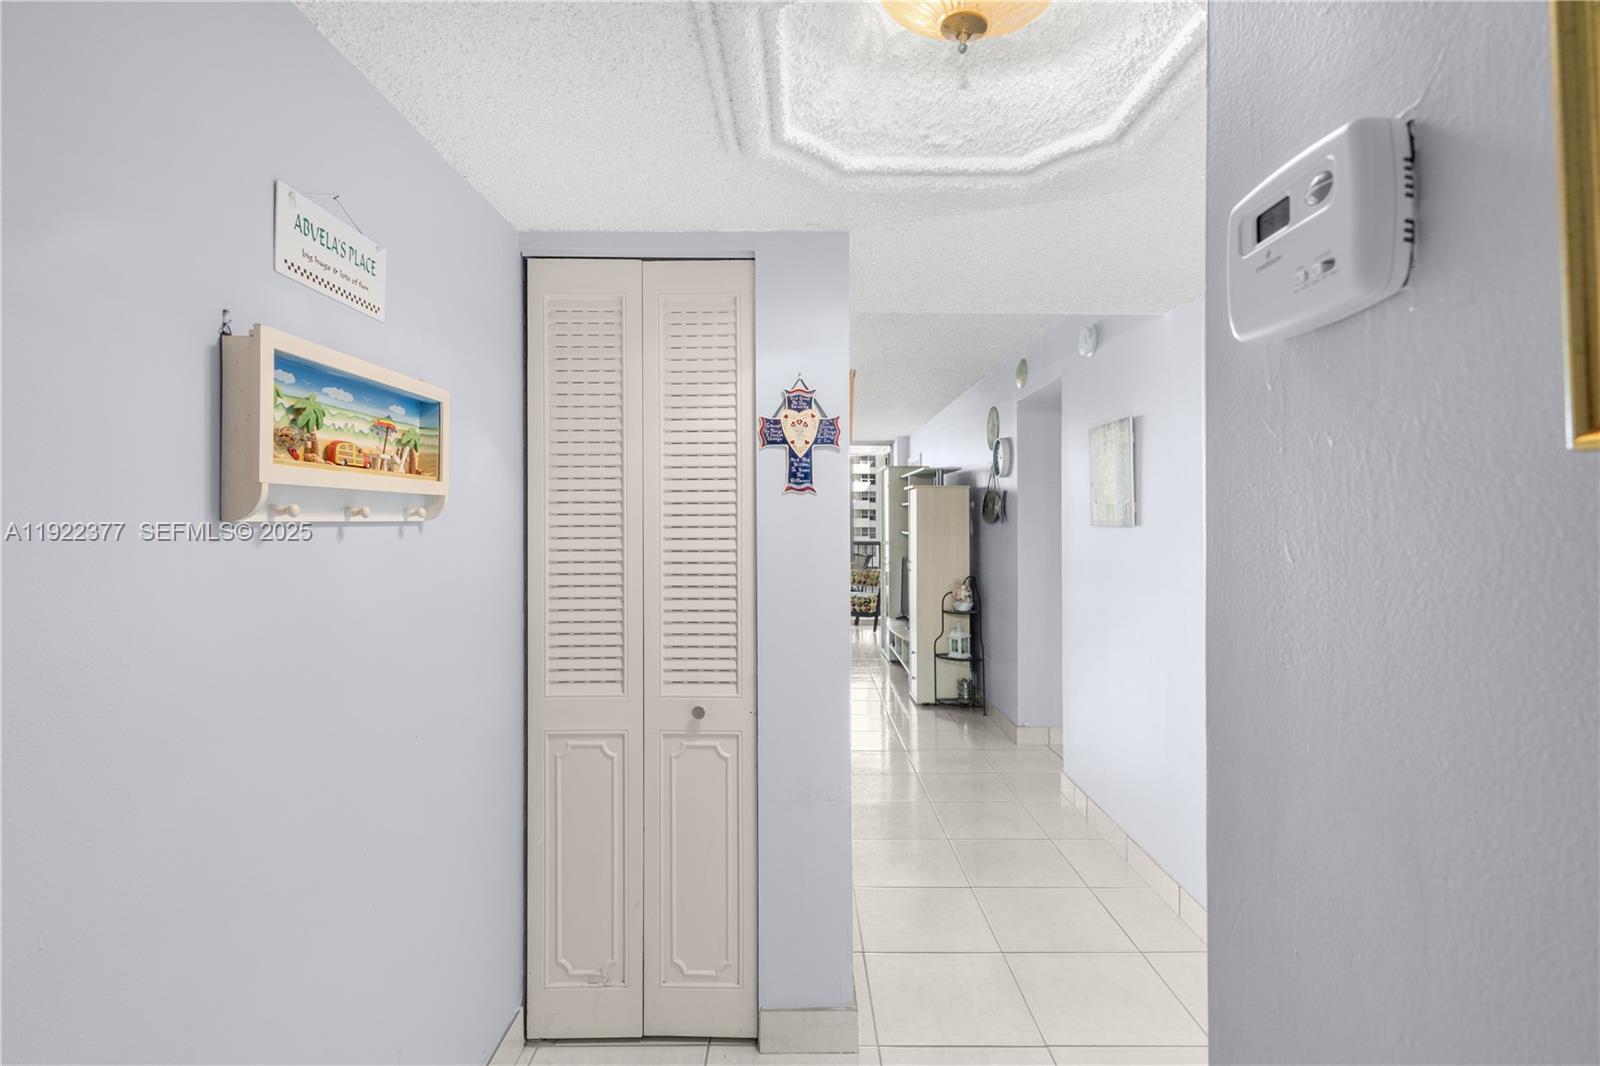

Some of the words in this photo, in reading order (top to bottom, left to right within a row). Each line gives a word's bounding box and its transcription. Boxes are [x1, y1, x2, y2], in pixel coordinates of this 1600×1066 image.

[293, 213, 346, 258] ABUELA'S
[349, 246, 376, 277] PLACE
[302, 248, 314, 263] big
[314, 255, 331, 271] hugs
[332, 267, 338, 275] &
[339, 269, 351, 282] lots
[352, 278, 358, 286] of
